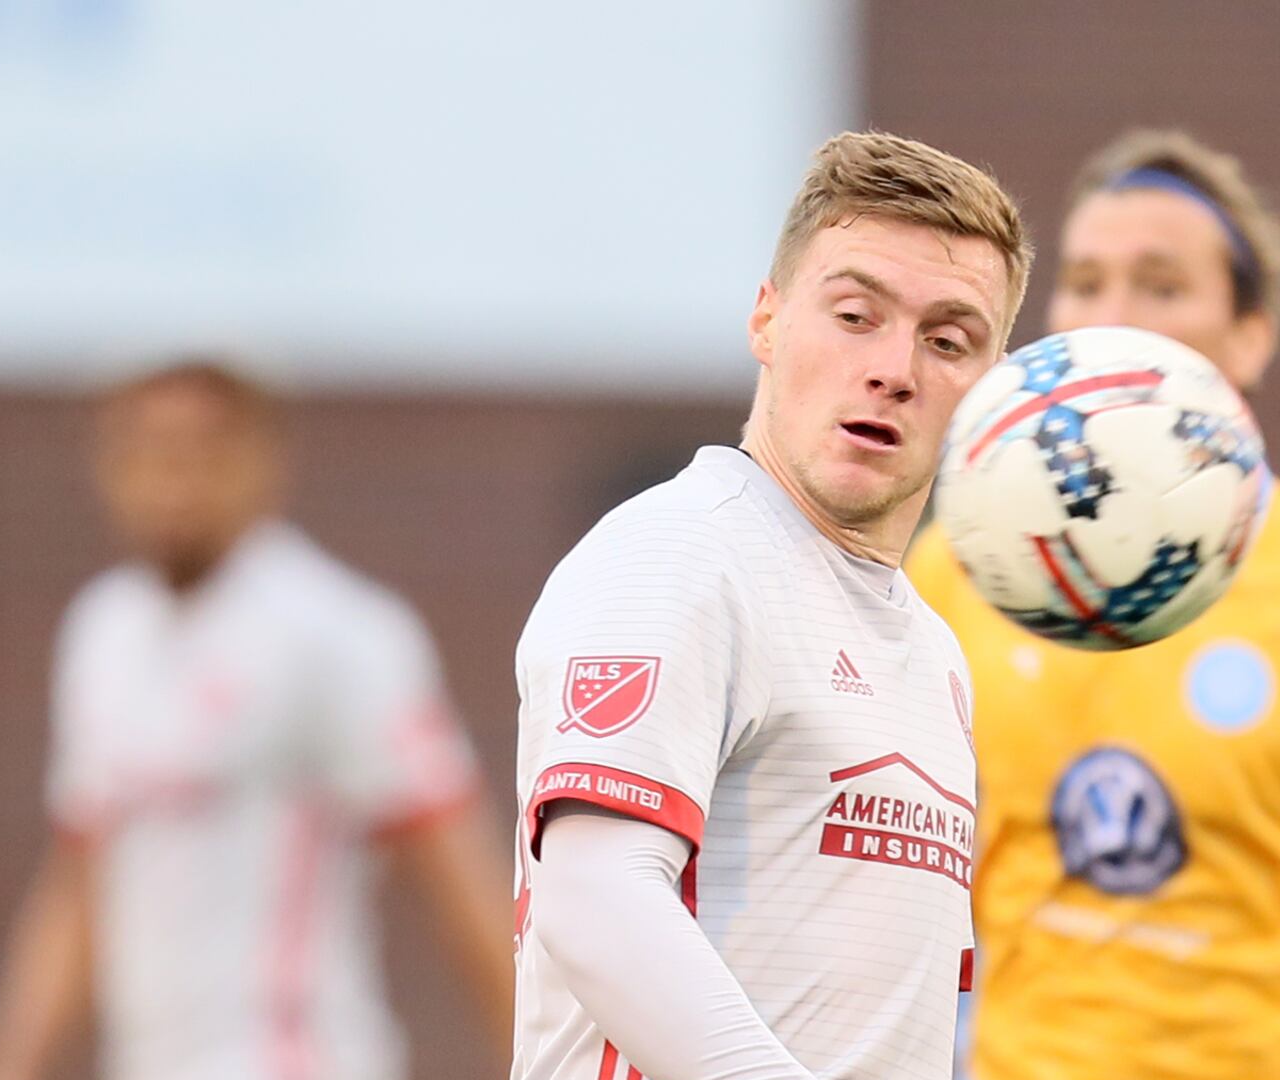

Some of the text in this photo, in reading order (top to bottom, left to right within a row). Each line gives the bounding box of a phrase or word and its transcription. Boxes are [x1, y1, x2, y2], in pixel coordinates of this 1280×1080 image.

[575, 664, 622, 681] MLS
[831, 675, 874, 697] adidas
[536, 772, 663, 811] LANTA UNITED
[826, 791, 947, 839] AMERICAN
